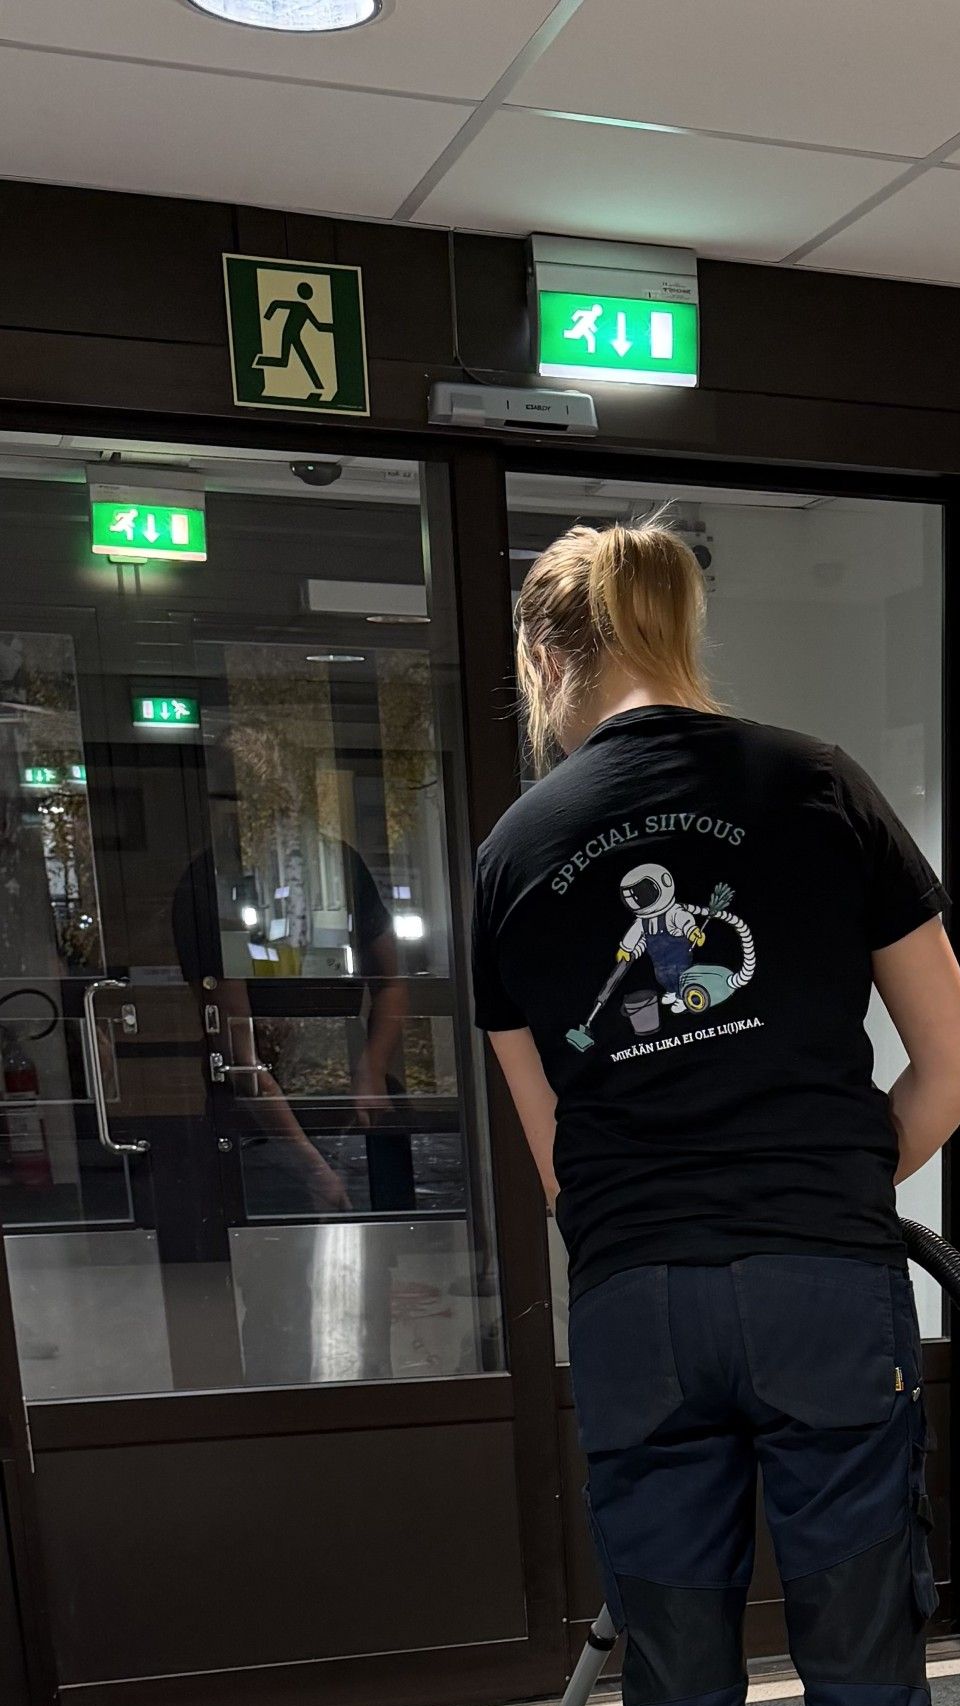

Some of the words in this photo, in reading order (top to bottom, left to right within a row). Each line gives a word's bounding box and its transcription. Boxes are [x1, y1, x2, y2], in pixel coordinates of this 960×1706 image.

[551, 821, 639, 896] SPECIAL
[645, 812, 746, 847] SIIVOUS
[610, 1043, 654, 1063] MIKÄÄN
[656, 1035, 682, 1051] LIKA
[683, 1031, 694, 1044] EI
[695, 1027, 716, 1040] OLE
[717, 1016, 765, 1036] LI(I)KAA.
